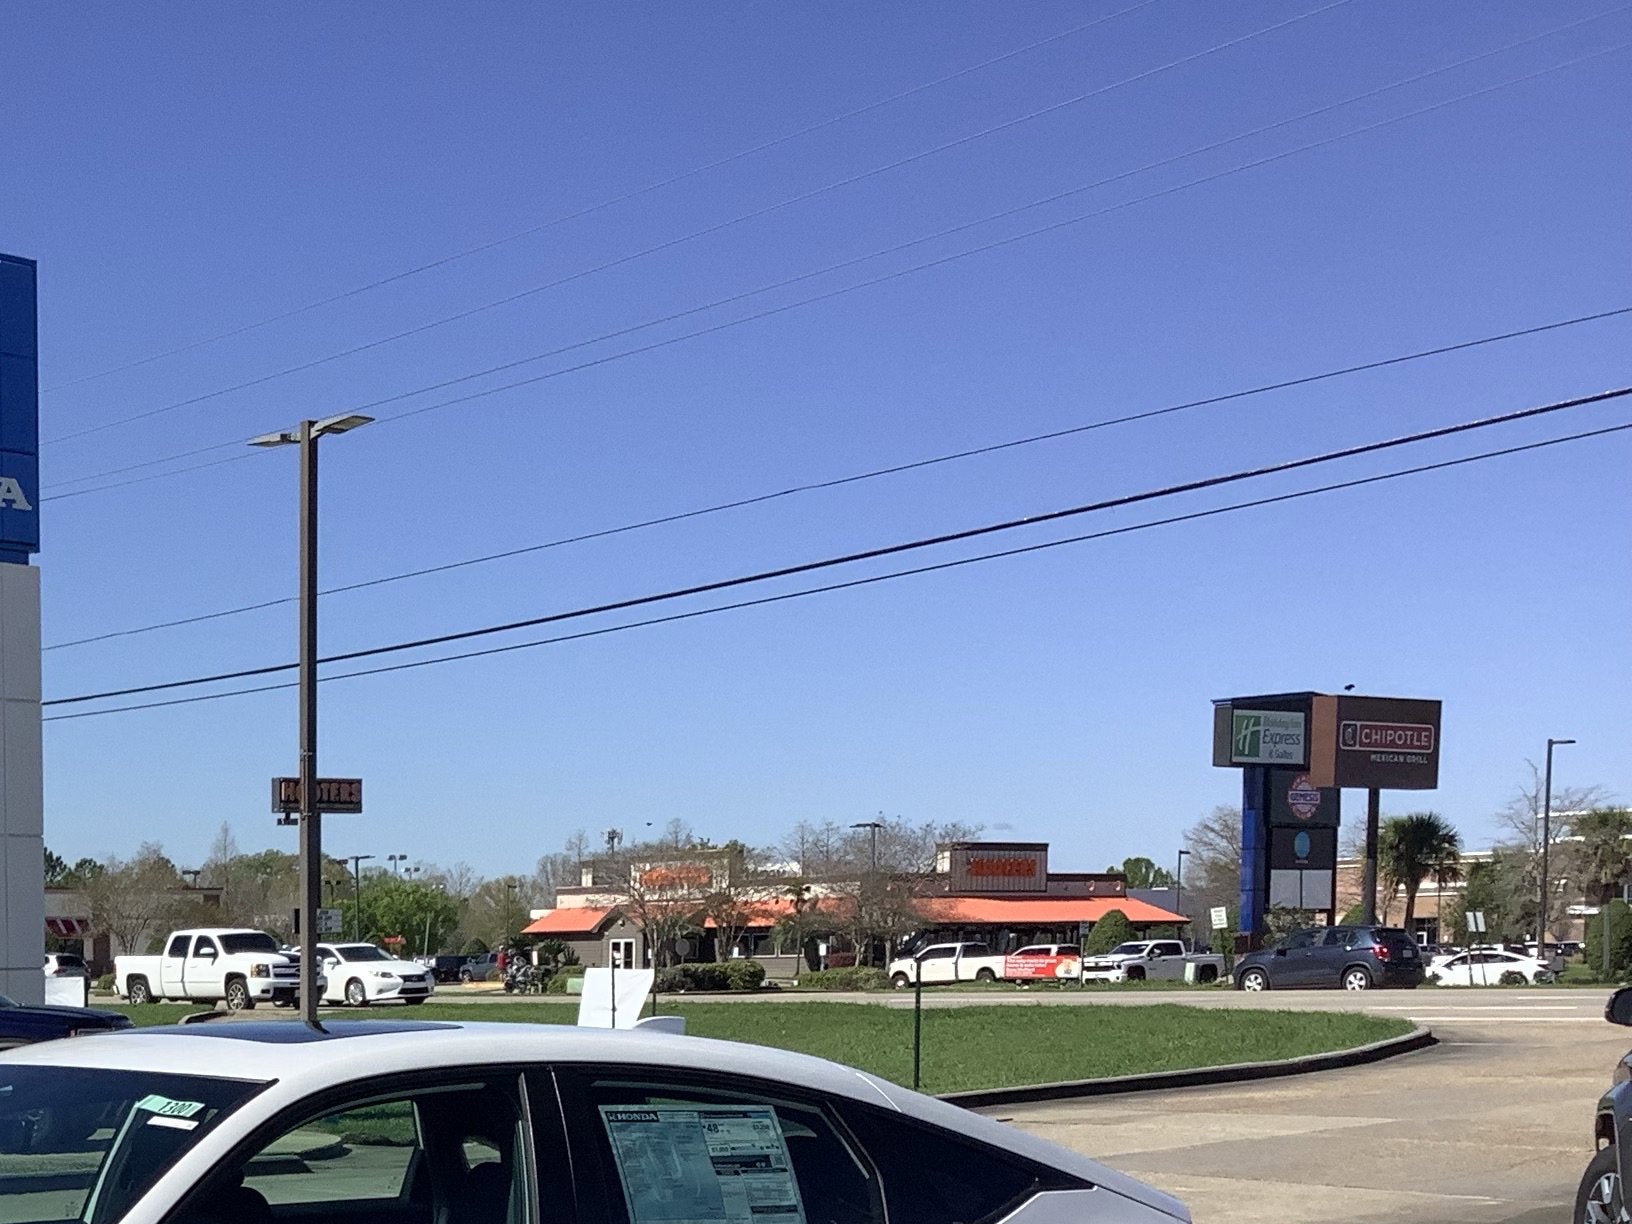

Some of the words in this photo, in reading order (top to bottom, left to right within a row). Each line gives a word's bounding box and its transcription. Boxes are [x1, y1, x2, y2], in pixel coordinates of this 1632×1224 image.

[1263, 728, 1300, 747] Express
[1362, 729, 1429, 745] CHIPOTLE
[1370, 754, 1404, 763] MEXICAN
[281, 782, 361, 802] HTERS
